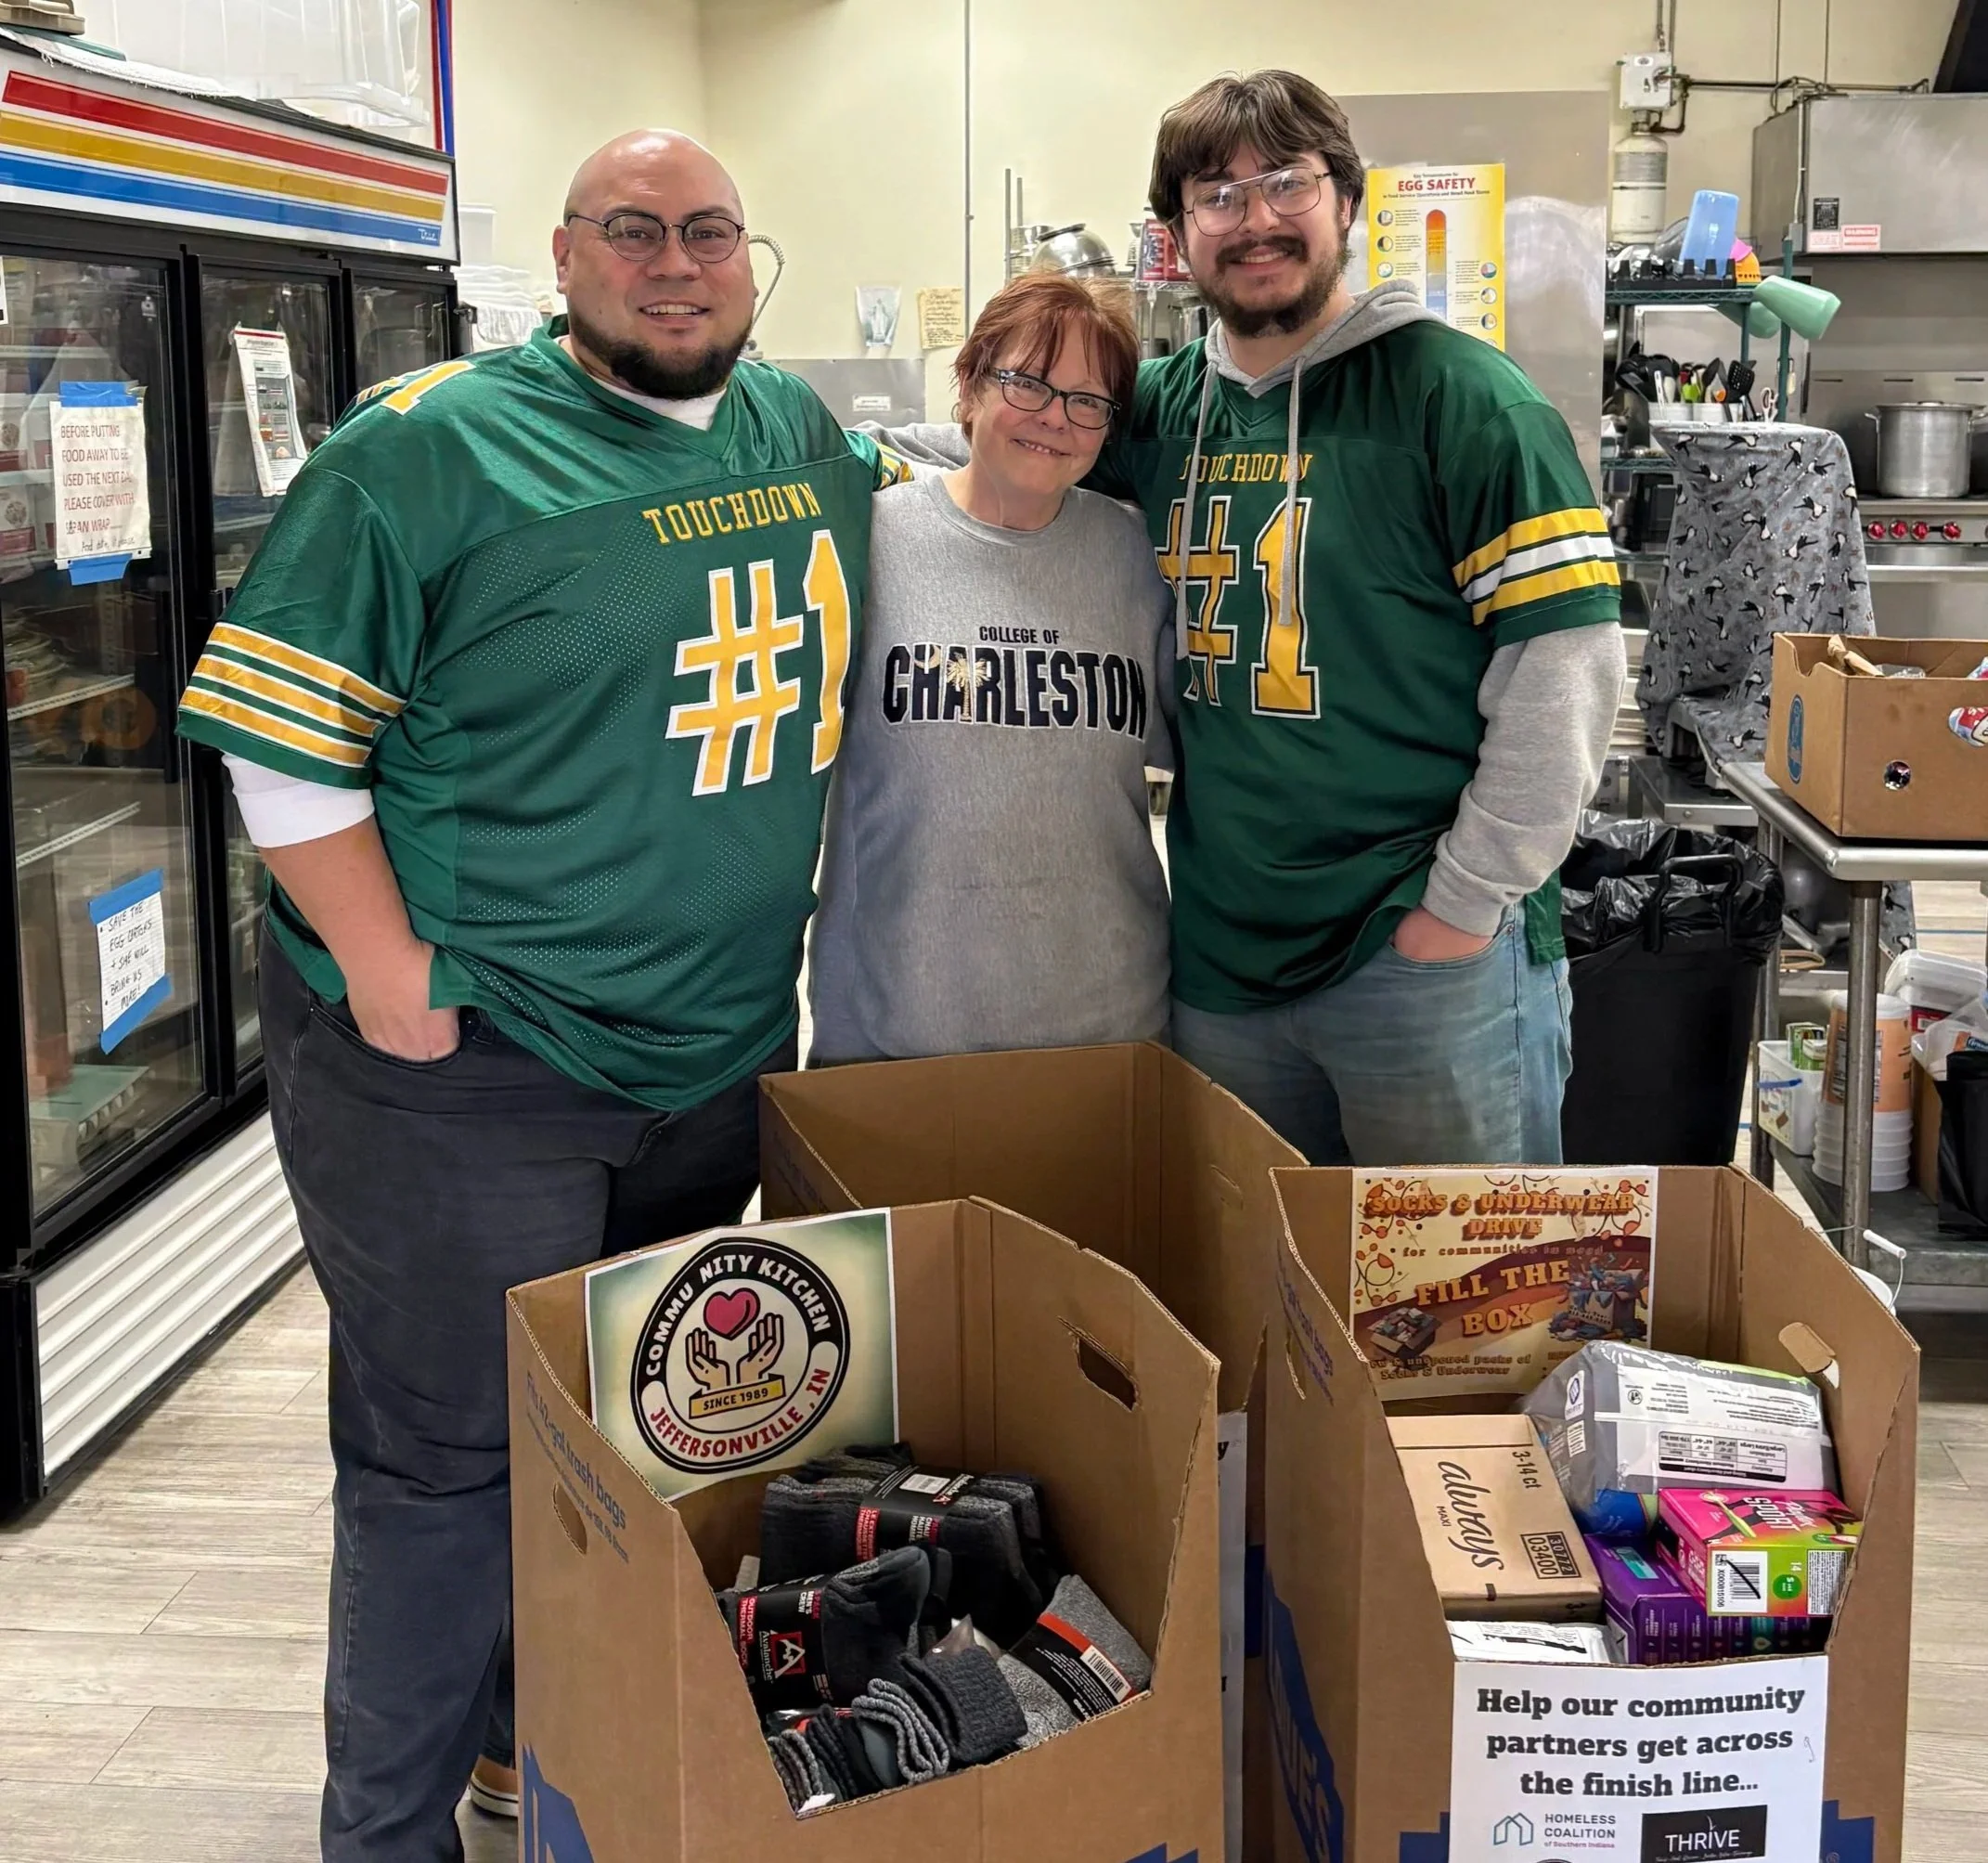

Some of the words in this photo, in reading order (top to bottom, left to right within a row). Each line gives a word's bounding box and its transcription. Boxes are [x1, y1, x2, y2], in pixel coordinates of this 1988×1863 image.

[1398, 180, 1424, 192] EGG
[1426, 177, 1476, 191] SAFETY
[61, 425, 90, 439] BEFORE
[91, 425, 121, 438] PUTTING
[61, 449, 85, 462] FOOD
[87, 448, 108, 461] AWAY
[110, 447, 119, 460] TO
[63, 473, 84, 486] USED
[85, 472, 100, 485] THE
[102, 472, 120, 485] NEXT
[64, 497, 92, 511] PLEASE
[93, 496, 115, 508] COVER
[642, 483, 823, 545] TOUCHDOWN
[979, 626, 1038, 644] COLLEGE
[1043, 628, 1060, 645] OF
[665, 528, 852, 797] #1
[882, 642, 1147, 743] CHARLESTON
[108, 912, 127, 933] SAVE
[130, 900, 144, 918] THE
[110, 933, 124, 952] EGG
[1366, 1194, 1449, 1216] SOCKS
[1452, 1194, 1471, 1214] &
[1477, 1193, 1634, 1215] UNDERWEAR
[1464, 1217, 1543, 1239] DRIVE
[1403, 1247, 1426, 1258] for
[1439, 1243, 1537, 1257] communities
[1415, 1274, 1489, 1307] FILL
[1501, 1260, 1570, 1291] THE
[756, 1259, 832, 1333] KITCHEN
[1462, 1303, 1534, 1337] BOX
[1370, 1358, 1387, 1368] ew
[1474, 1353, 1513, 1365] packs
[1437, 1366, 1510, 1377] Underwear
[703, 1393, 737, 1411] SINCE
[740, 1387, 768, 1404] 1989
[650, 1405, 805, 1458] JEFFERSONVILLE
[806, 1368, 831, 1397] IN
[1512, 1451, 1537, 1476] 3-14
[566, 1440, 595, 1493] trash
[597, 1474, 626, 1530] bags
[1523, 1476, 1542, 1490] ct
[1436, 1506, 1452, 1527] MAXI
[1438, 1460, 1504, 1572] always
[1743, 1496, 1801, 1532] SPORT
[1529, 1536, 1559, 1576] 03400
[1790, 1561, 1802, 1572] 14
[798, 1591, 807, 1613] CREW
[740, 1598, 748, 1639] THERMAL
[747, 1598, 756, 1641] OUTDOOR
[761, 1630, 773, 1682] Avalanche
[1476, 1688, 1552, 1720] Help
[1561, 1693, 1619, 1716] our
[1628, 1687, 1805, 1719] community
[1486, 1733, 1628, 1759] partners
[1637, 1734, 1687, 1765] get
[1697, 1728, 1793, 1755] across
[1520, 1771, 1573, 1795] the
[1582, 1772, 1672, 1797] finish
[1682, 1770, 1759, 1795] line...
[1544, 1813, 1617, 1825] HOMELESS
[1544, 1827, 1615, 1839] COALITION
[1665, 1829, 1741, 1853] THRIVE
